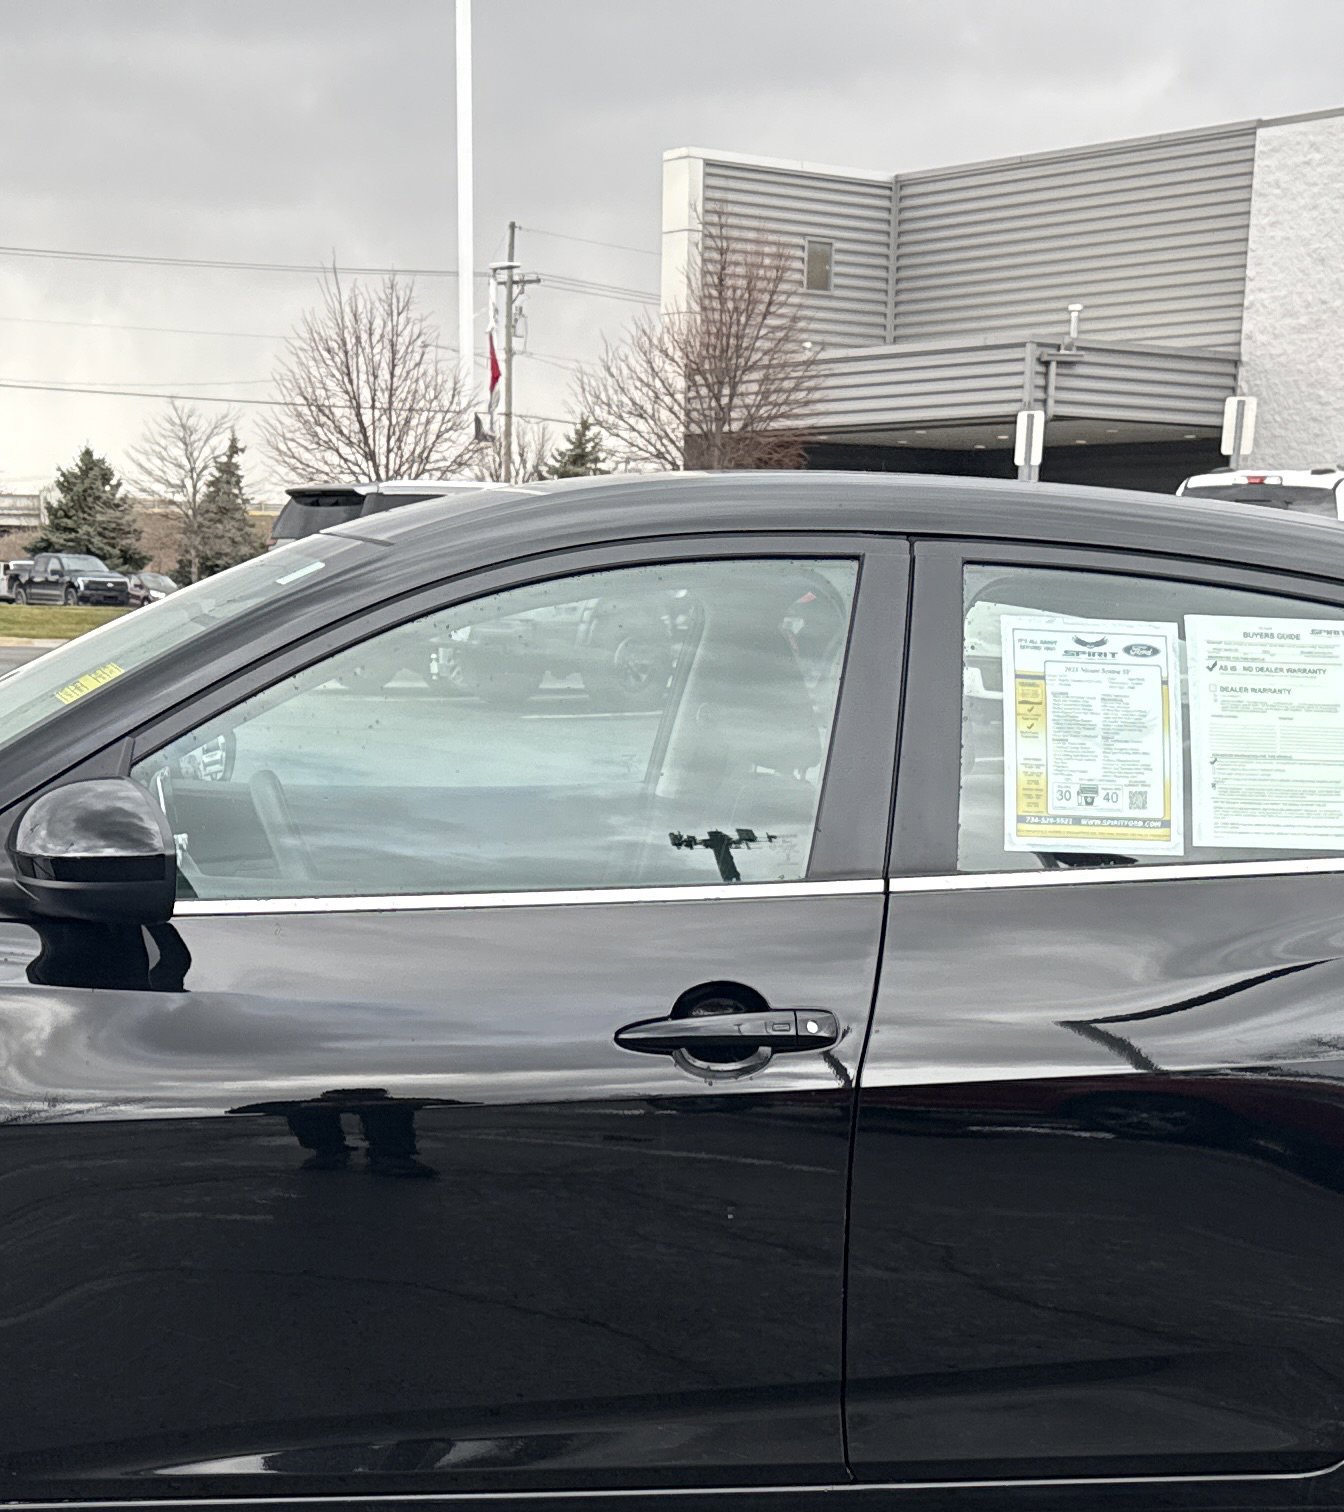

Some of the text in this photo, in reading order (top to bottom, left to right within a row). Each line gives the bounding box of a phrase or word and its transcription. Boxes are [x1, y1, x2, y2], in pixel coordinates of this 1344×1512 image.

[1276, 632, 1301, 641] GUIDE
[1062, 649, 1119, 659] SPIRIT
[1255, 665, 1285, 674] DEALER
[1285, 667, 1327, 675] WARRANTY
[1219, 685, 1292, 696] DEALER WARRANTY
[1055, 789, 1072, 802] 30
[1102, 791, 1119, 804] 40
